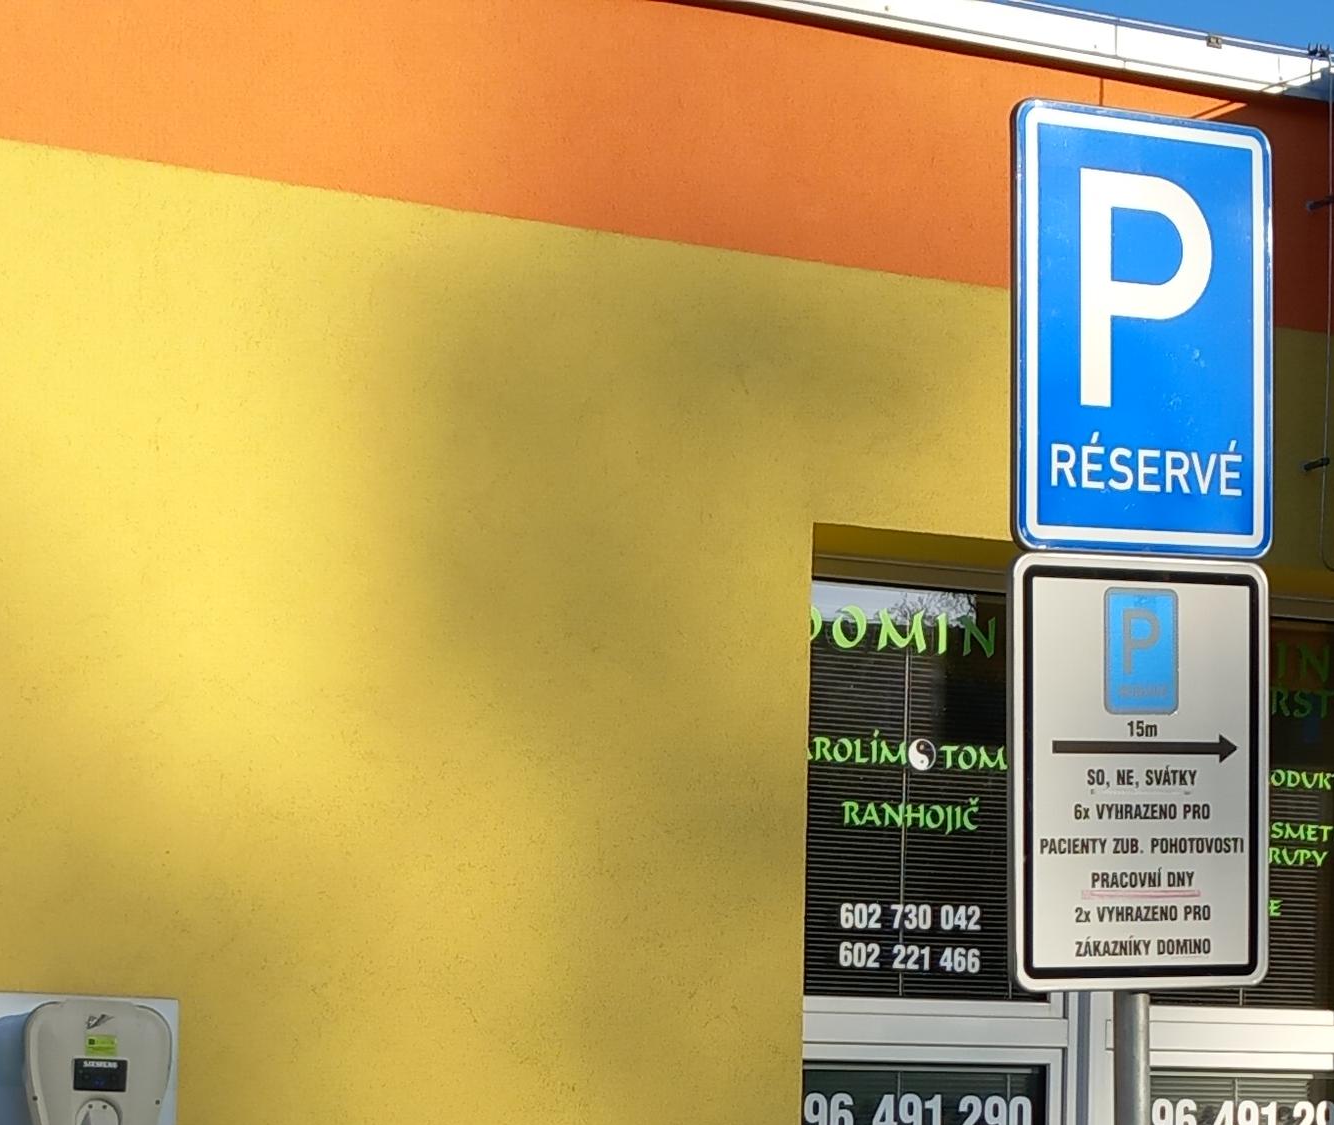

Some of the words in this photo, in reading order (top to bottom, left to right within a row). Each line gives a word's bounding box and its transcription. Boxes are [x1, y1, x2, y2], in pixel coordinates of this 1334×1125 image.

[1080, 167, 1213, 408] P
[1050, 431, 1243, 497] RÉSERVÉ
[1122, 607, 1160, 675] P
[1127, 720, 1158, 737] 15m
[807, 729, 907, 765] ROLÍM
[1087, 768, 1110, 788] SO,
[1117, 769, 1140, 788] NE,
[1145, 765, 1198, 786] SVÁTKY
[842, 797, 979, 835] RANHOJIČ
[1074, 804, 1090, 820] 6x
[1096, 804, 1177, 820] VYHRAZENO
[1183, 803, 1210, 819] PRO
[1040, 838, 1107, 854] PACIENTY
[1113, 838, 1144, 854] ZUB.
[1151, 837, 1245, 853] POHOTOVOSTI
[1091, 867, 1162, 888] PRACOVNÍ
[1168, 871, 1194, 887] DNY
[840, 903, 882, 929] 602
[890, 904, 932, 929] 730
[940, 905, 981, 930] 042
[1075, 906, 1091, 922] 2x
[1097, 905, 1178, 922] VYHRAZENO
[1184, 905, 1211, 920] PRO
[839, 941, 880, 968] 602
[892, 944, 930, 970] 221
[939, 947, 980, 973] 466
[1075, 935, 1151, 957] ZÁKAZNÍKY
[1157, 938, 1211, 954] DOMINO
